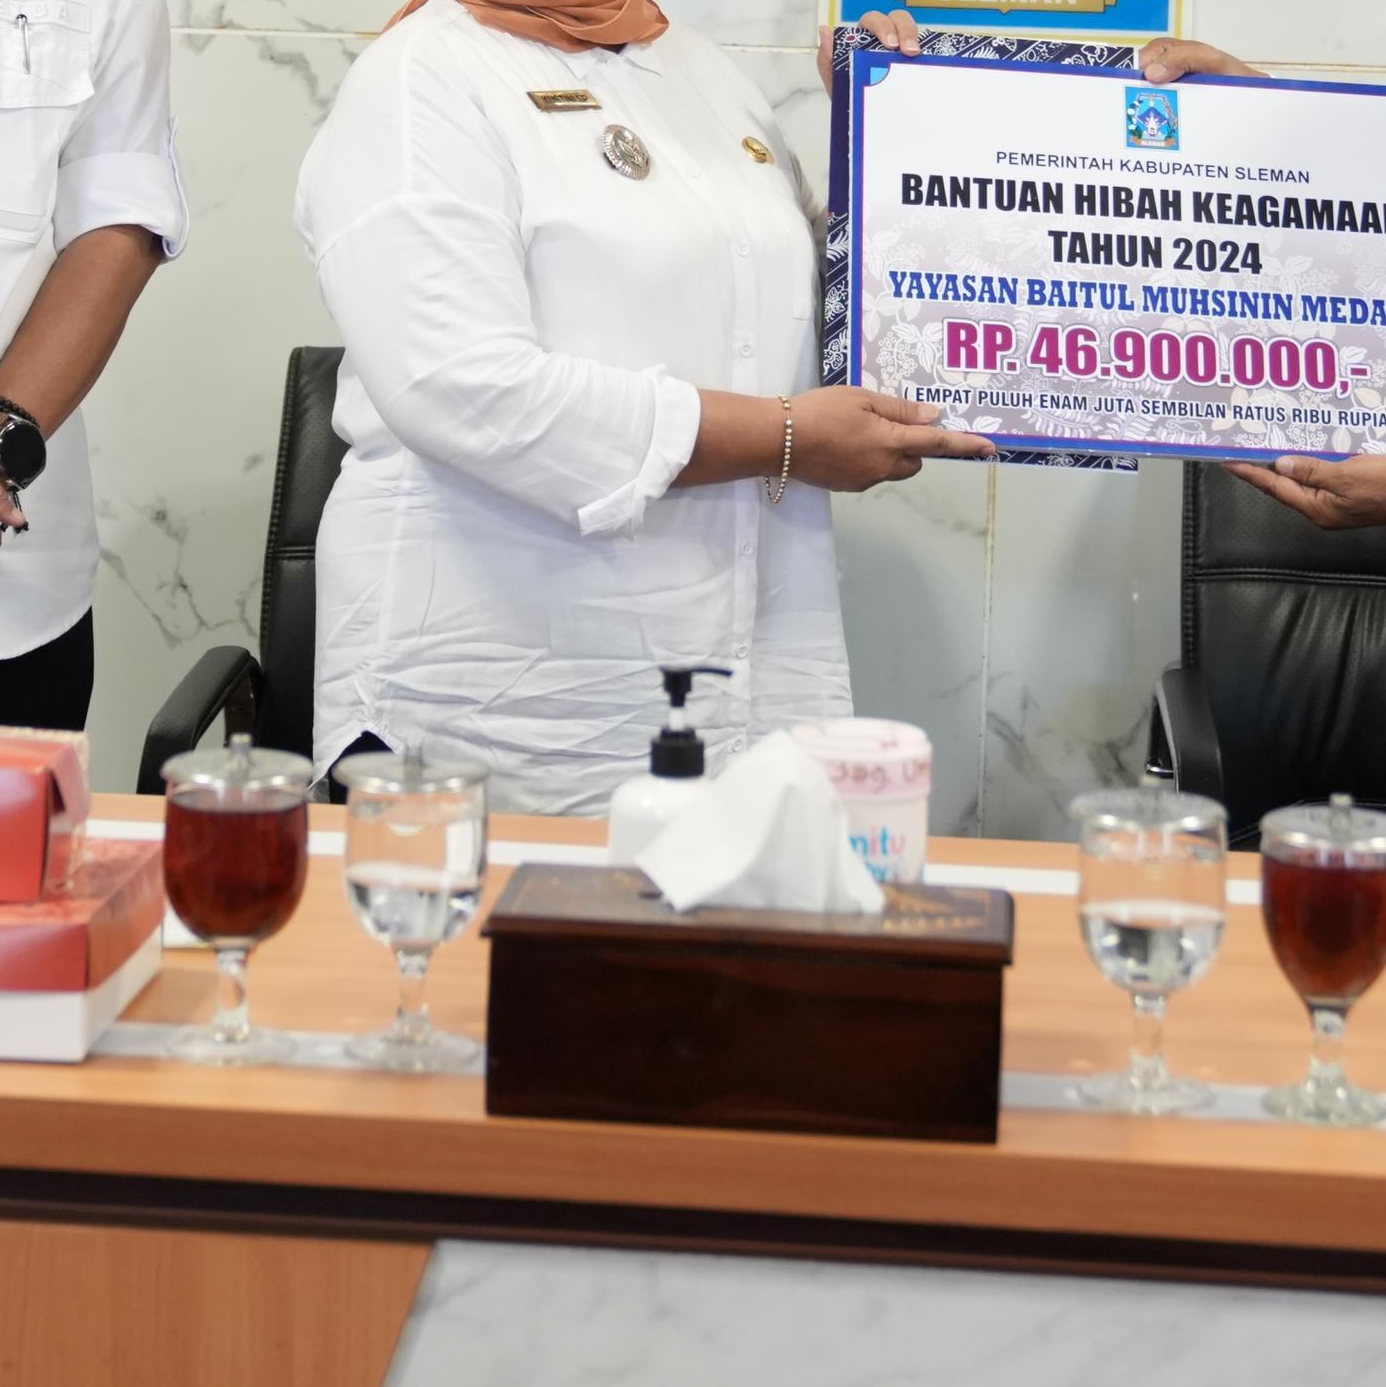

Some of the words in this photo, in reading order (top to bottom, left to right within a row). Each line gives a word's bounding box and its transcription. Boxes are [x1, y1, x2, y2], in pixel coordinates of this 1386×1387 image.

[996, 151, 1113, 171] PEMERINTAH
[1119, 158, 1229, 179] KABUPATEN
[1235, 166, 1310, 184] SLEMAN
[901, 172, 1064, 214] BANTUAN
[1074, 183, 1182, 222] HIBAH
[1047, 229, 1163, 269] TAHUN
[1172, 237, 1263, 275] 2024
[888, 270, 1019, 305] YAYASAN
[1026, 278, 1135, 311] BAITUL
[1141, 285, 1293, 321] MUHSININ
[946, 321, 1017, 372] RP.
[1029, 326, 1368, 395] 46.900.000,-
[915, 387, 972, 405] EMPAT
[978, 390, 1033, 408] PULUH
[1040, 394, 1087, 411] ENAM
[1094, 397, 1135, 414] JUTA
[1141, 399, 1226, 419] SEMBILAN
[1233, 405, 1286, 423] RATUS
[1292, 408, 1332, 425] RIBU
